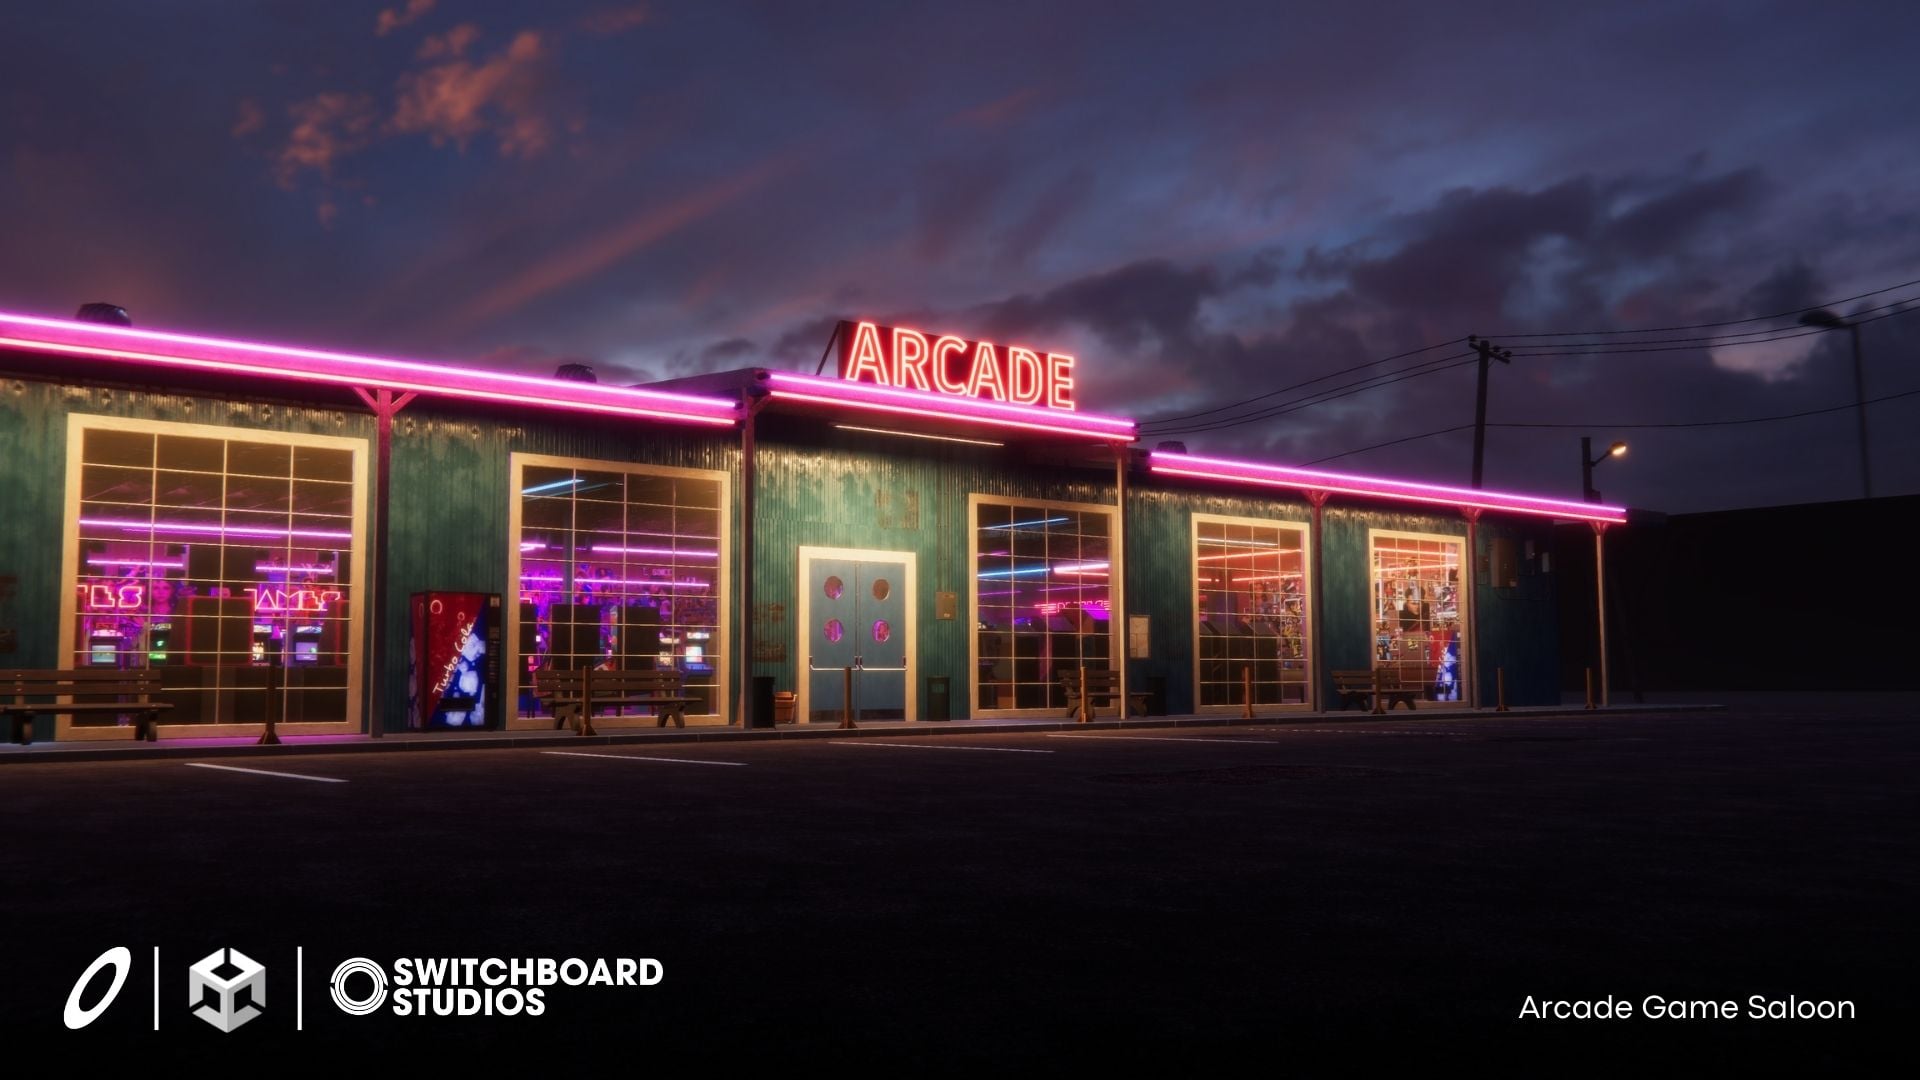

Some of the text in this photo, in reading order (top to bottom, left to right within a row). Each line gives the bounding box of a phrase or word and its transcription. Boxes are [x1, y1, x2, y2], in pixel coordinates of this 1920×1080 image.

[846, 322, 1075, 411] ARCADE
[432, 619, 476, 694] Turbo Cola
